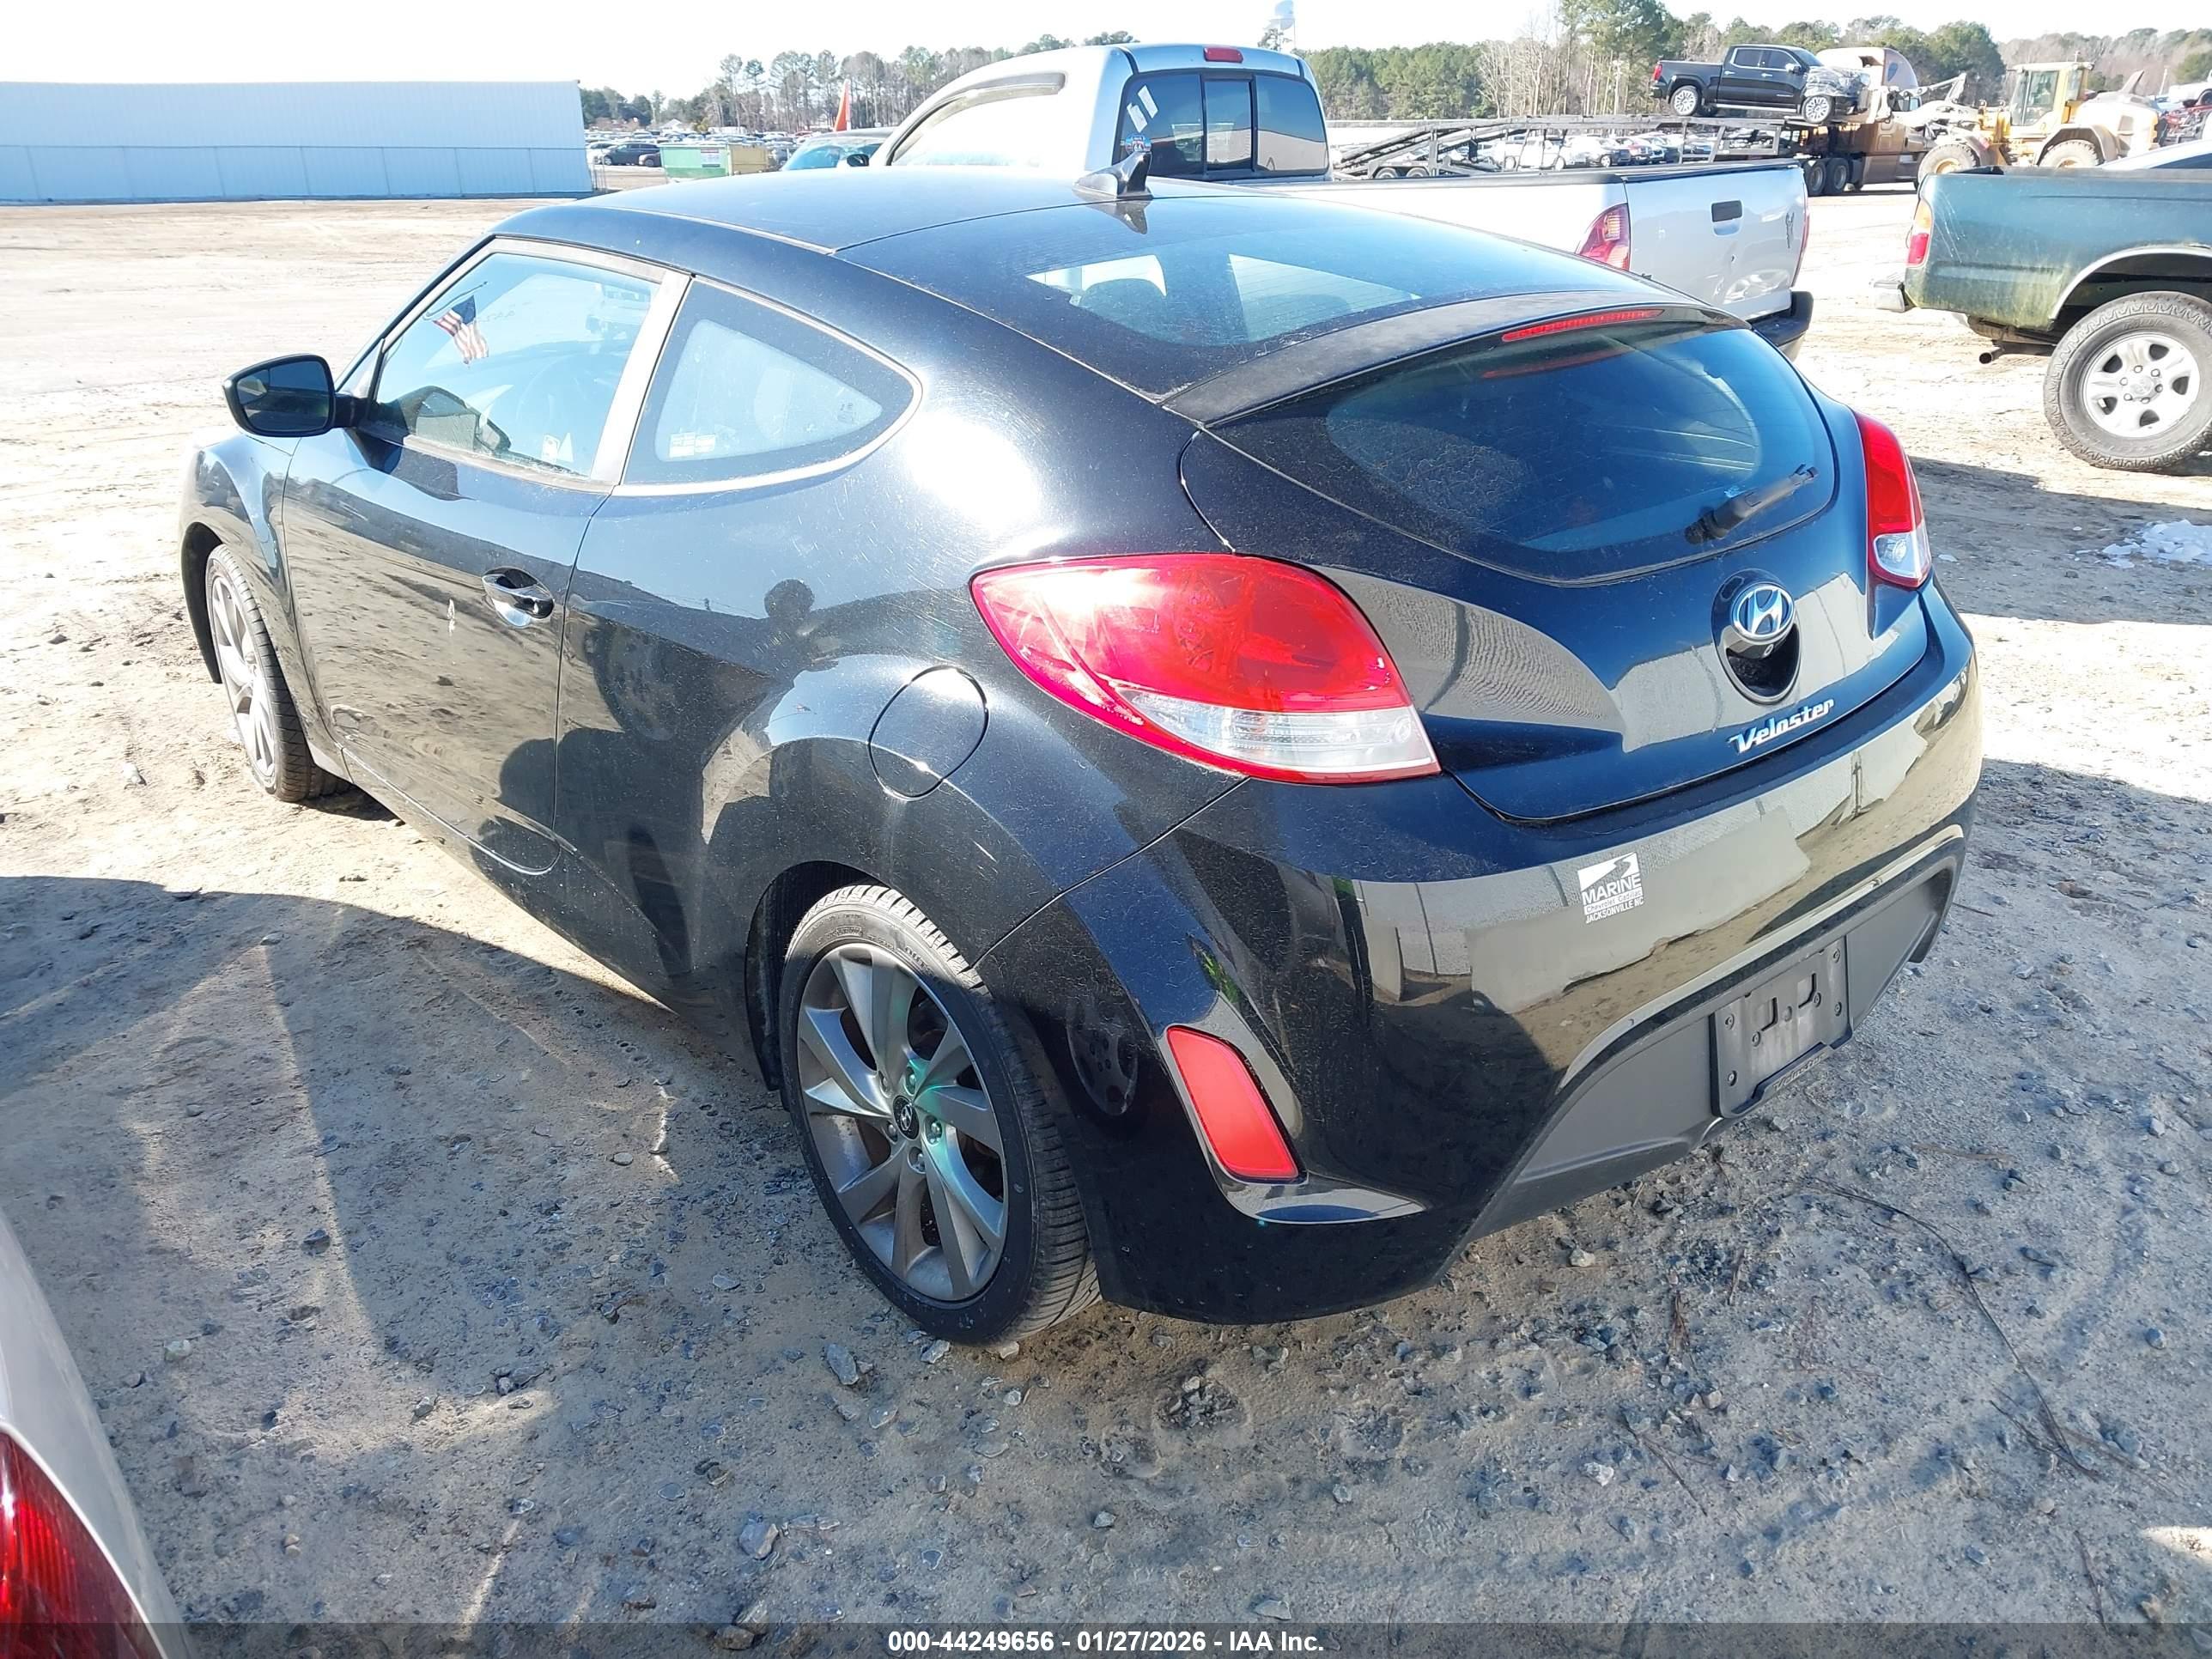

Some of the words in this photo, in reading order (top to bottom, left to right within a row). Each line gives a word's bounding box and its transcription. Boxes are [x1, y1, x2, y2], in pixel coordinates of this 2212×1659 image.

[1728, 698, 1834, 753] Veloster
[1581, 872, 1642, 906] MARINE
[1586, 899, 1634, 924] JACKSONVILLE
[1634, 896, 1644, 907] NC
